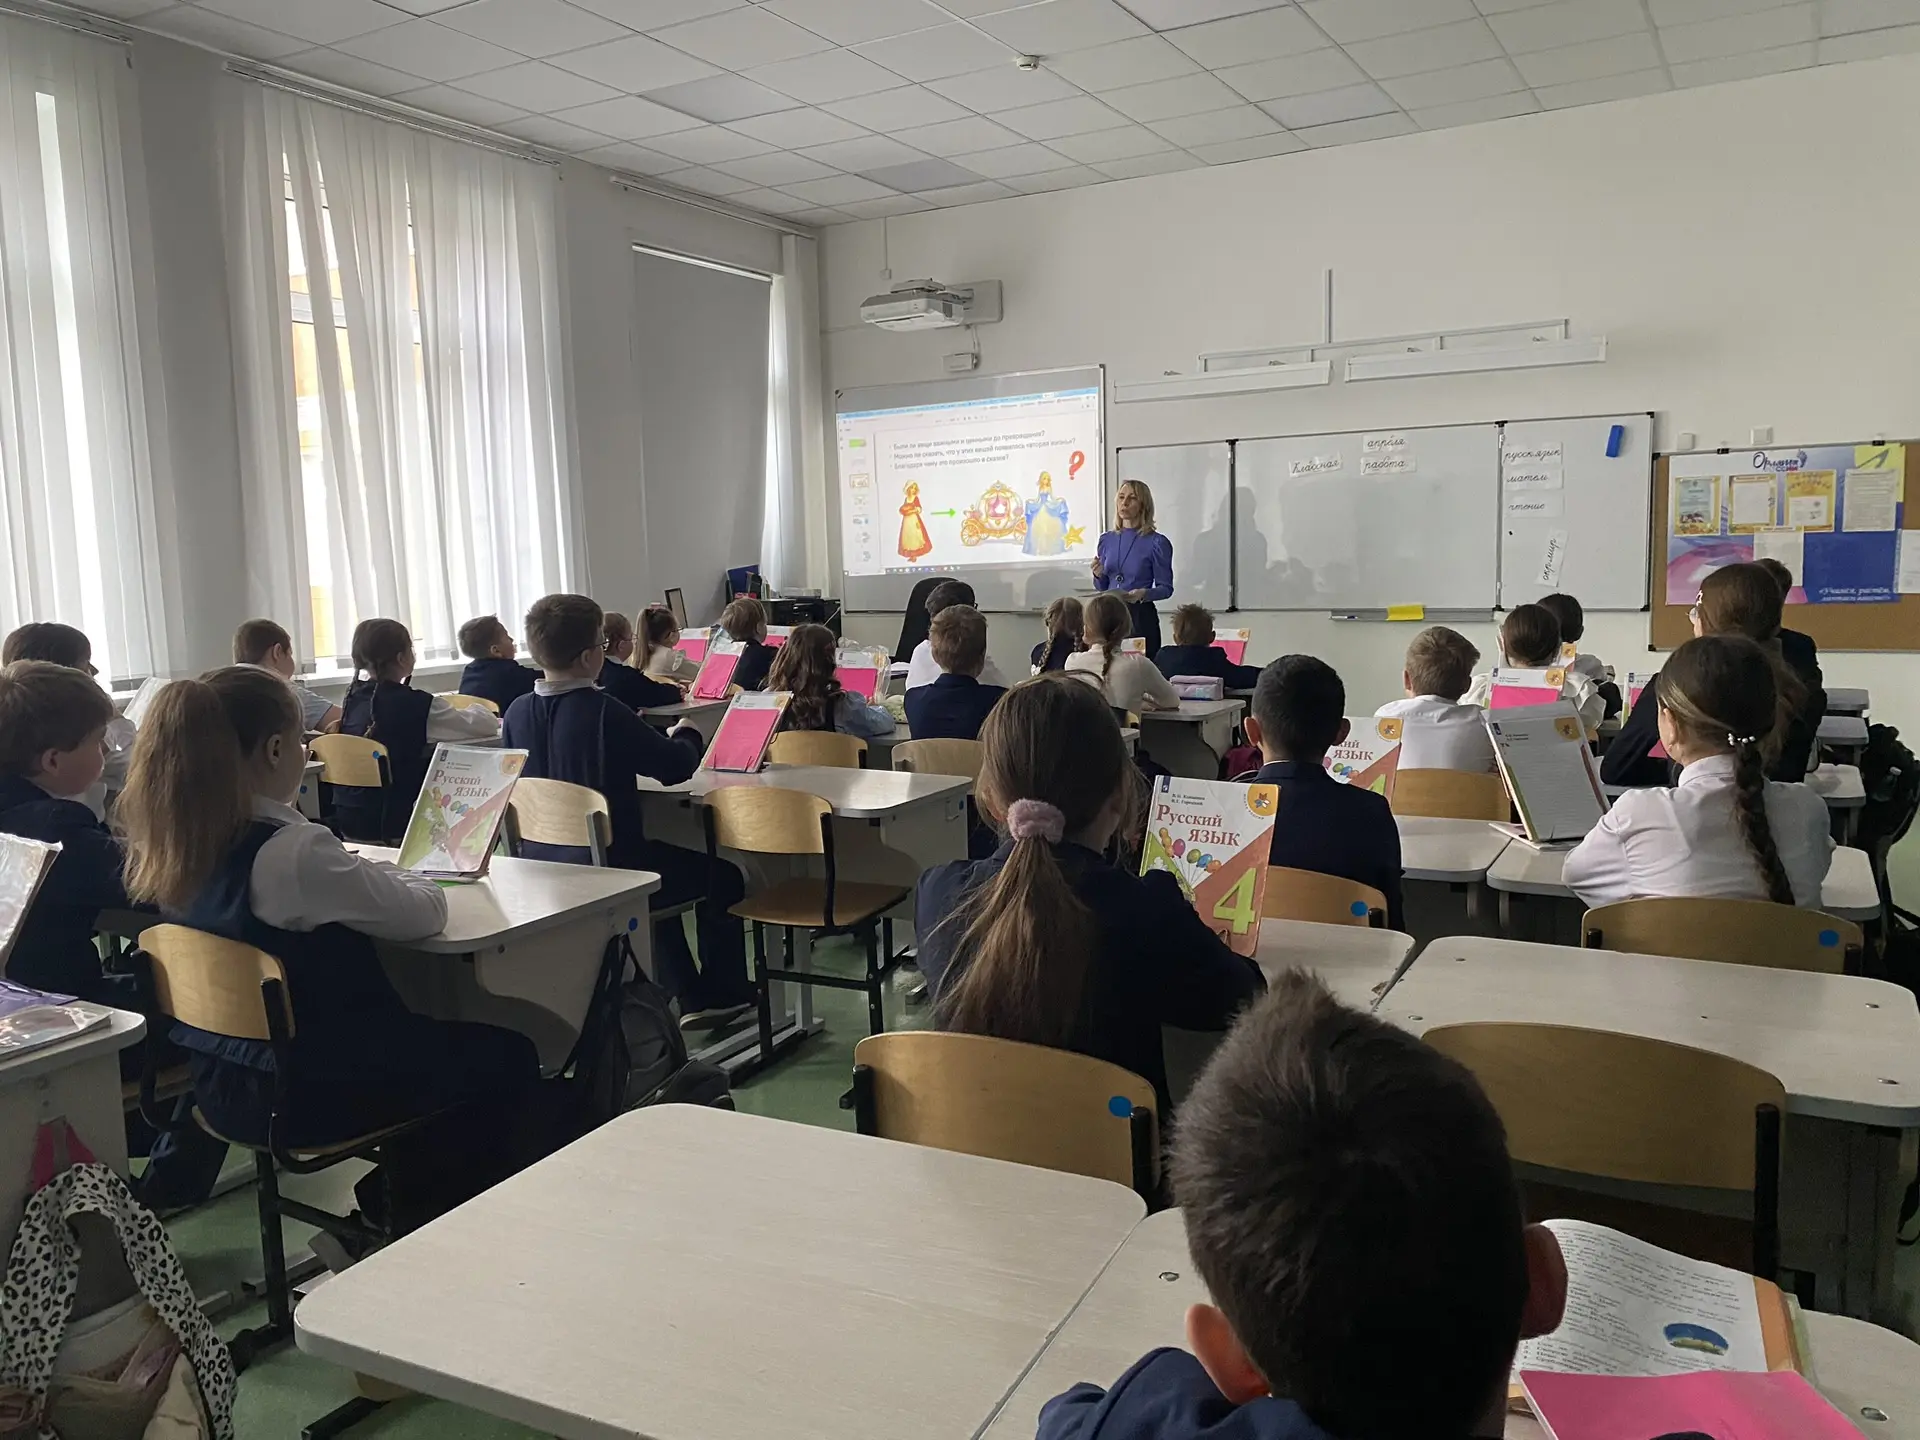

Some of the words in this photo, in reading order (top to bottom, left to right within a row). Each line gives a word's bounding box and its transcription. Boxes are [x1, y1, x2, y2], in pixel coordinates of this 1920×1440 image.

[432, 769, 481, 785] Русский
[1156, 804, 1223, 827] Русский
[460, 811, 496, 855] 4
[1213, 867, 1258, 935] 4
